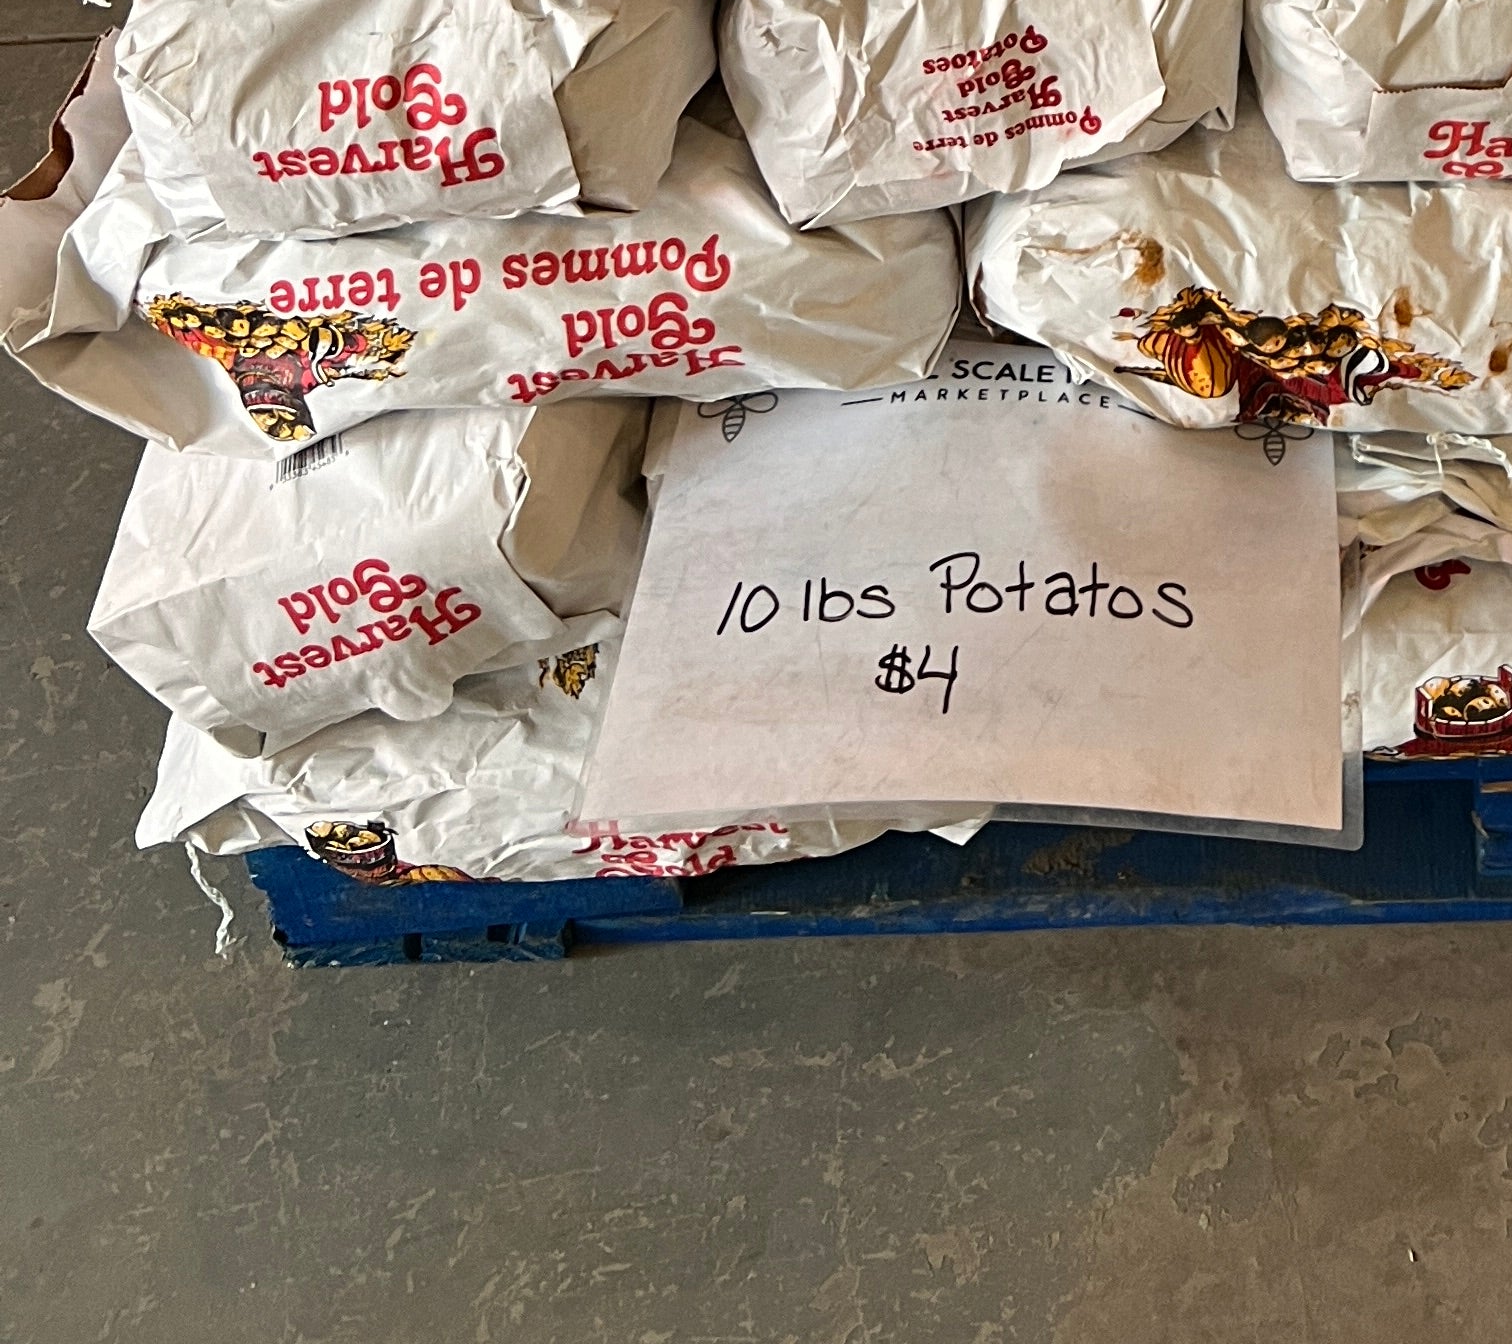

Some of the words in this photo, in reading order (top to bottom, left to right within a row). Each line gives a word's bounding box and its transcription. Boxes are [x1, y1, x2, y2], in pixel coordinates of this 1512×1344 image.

[921, 23, 1049, 76] Potatoes
[958, 57, 1040, 98] Gold
[317, 62, 467, 132] Gold
[942, 74, 1064, 130] Harvest
[911, 134, 965, 158] terre
[970, 122, 1003, 150] de
[1004, 105, 1103, 147] Pommes
[255, 126, 507, 189] Harvest
[268, 267, 401, 315] terre
[419, 257, 483, 314] de
[503, 232, 733, 295] Pommes
[564, 290, 718, 352] Gold
[506, 345, 746, 407] Harvest
[890, 387, 1110, 410] MARKETPLACE
[951, 359, 1055, 384] SCALE
[278, 557, 429, 633] Gold
[717, 579, 780, 637] 10
[801, 557, 896, 622] lbs
[928, 552, 1195, 630] Potatos
[253, 585, 484, 692] Harvest
[874, 644, 960, 714] $4
